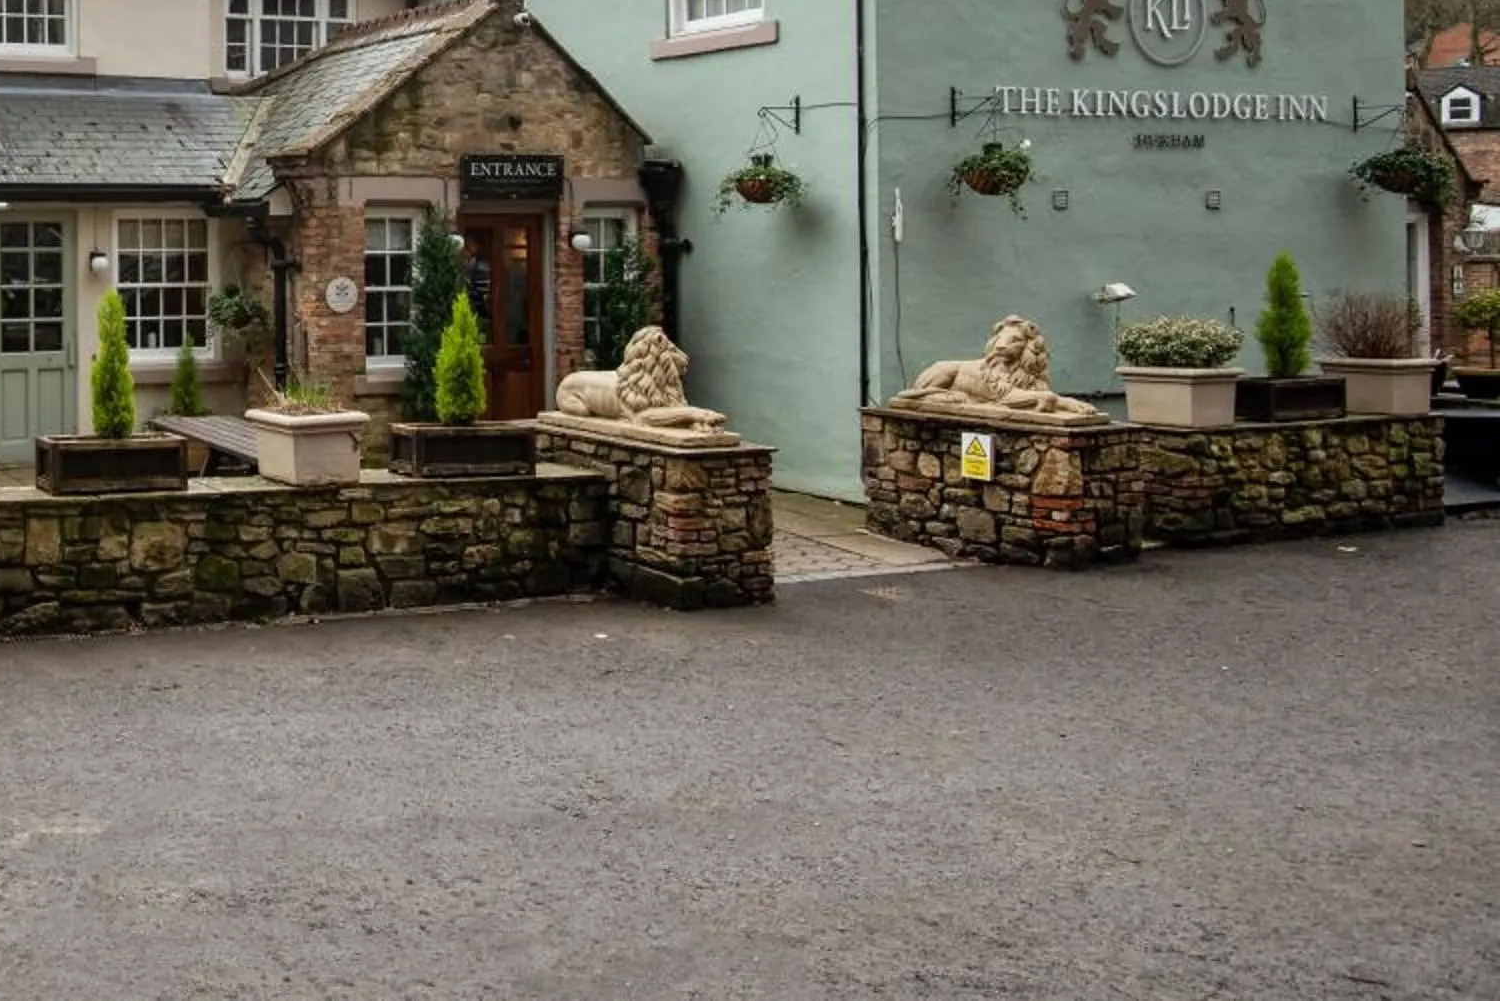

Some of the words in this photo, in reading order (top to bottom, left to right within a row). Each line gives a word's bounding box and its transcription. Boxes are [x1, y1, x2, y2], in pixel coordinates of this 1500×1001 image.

[995, 85, 1061, 115] THE
[1071, 89, 1269, 121] KINGSLODGE
[1278, 94, 1329, 121] INN
[470, 162, 557, 177] ENTRANCE
